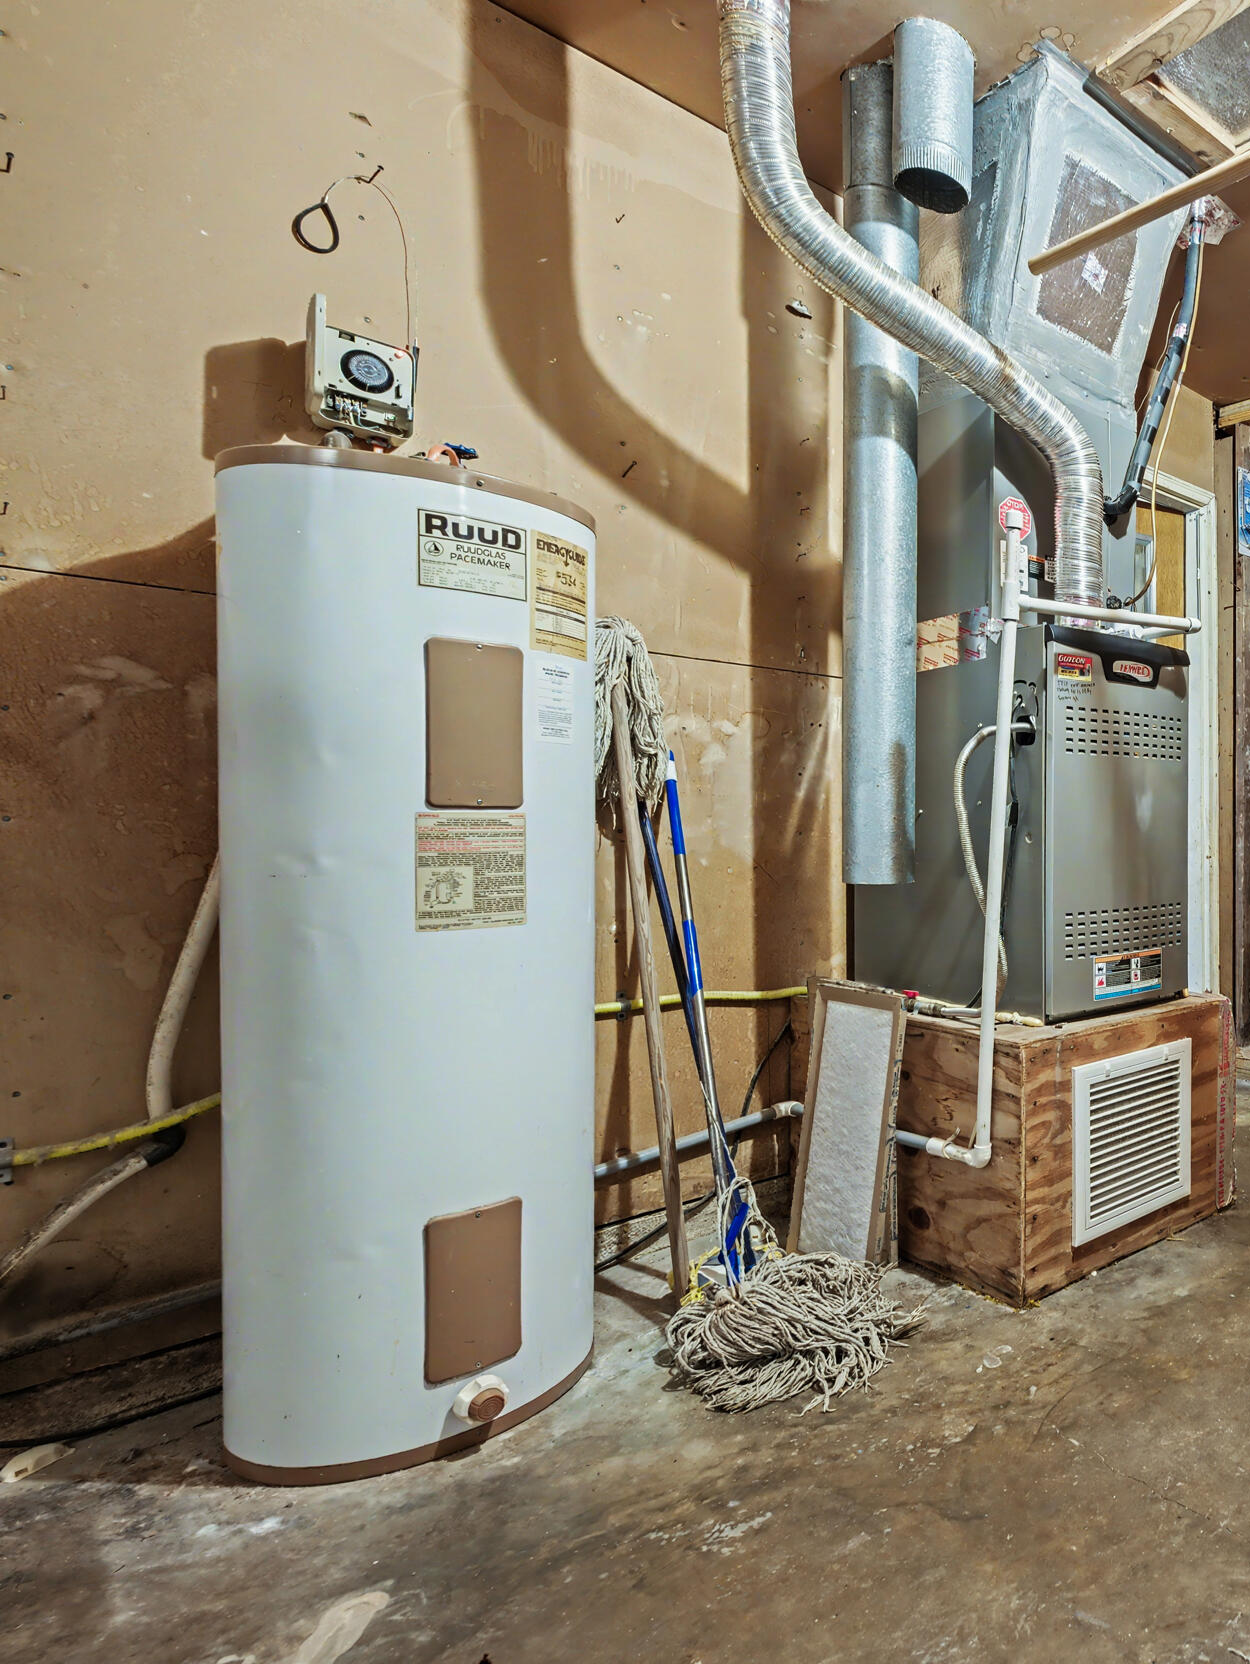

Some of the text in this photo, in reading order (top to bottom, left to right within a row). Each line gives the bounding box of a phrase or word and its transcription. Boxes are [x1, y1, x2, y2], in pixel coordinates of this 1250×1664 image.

[424, 513, 522, 550] RUUD
[450, 552, 511, 571] PACEMAKER
[455, 544, 507, 561] RUUDGLAS
